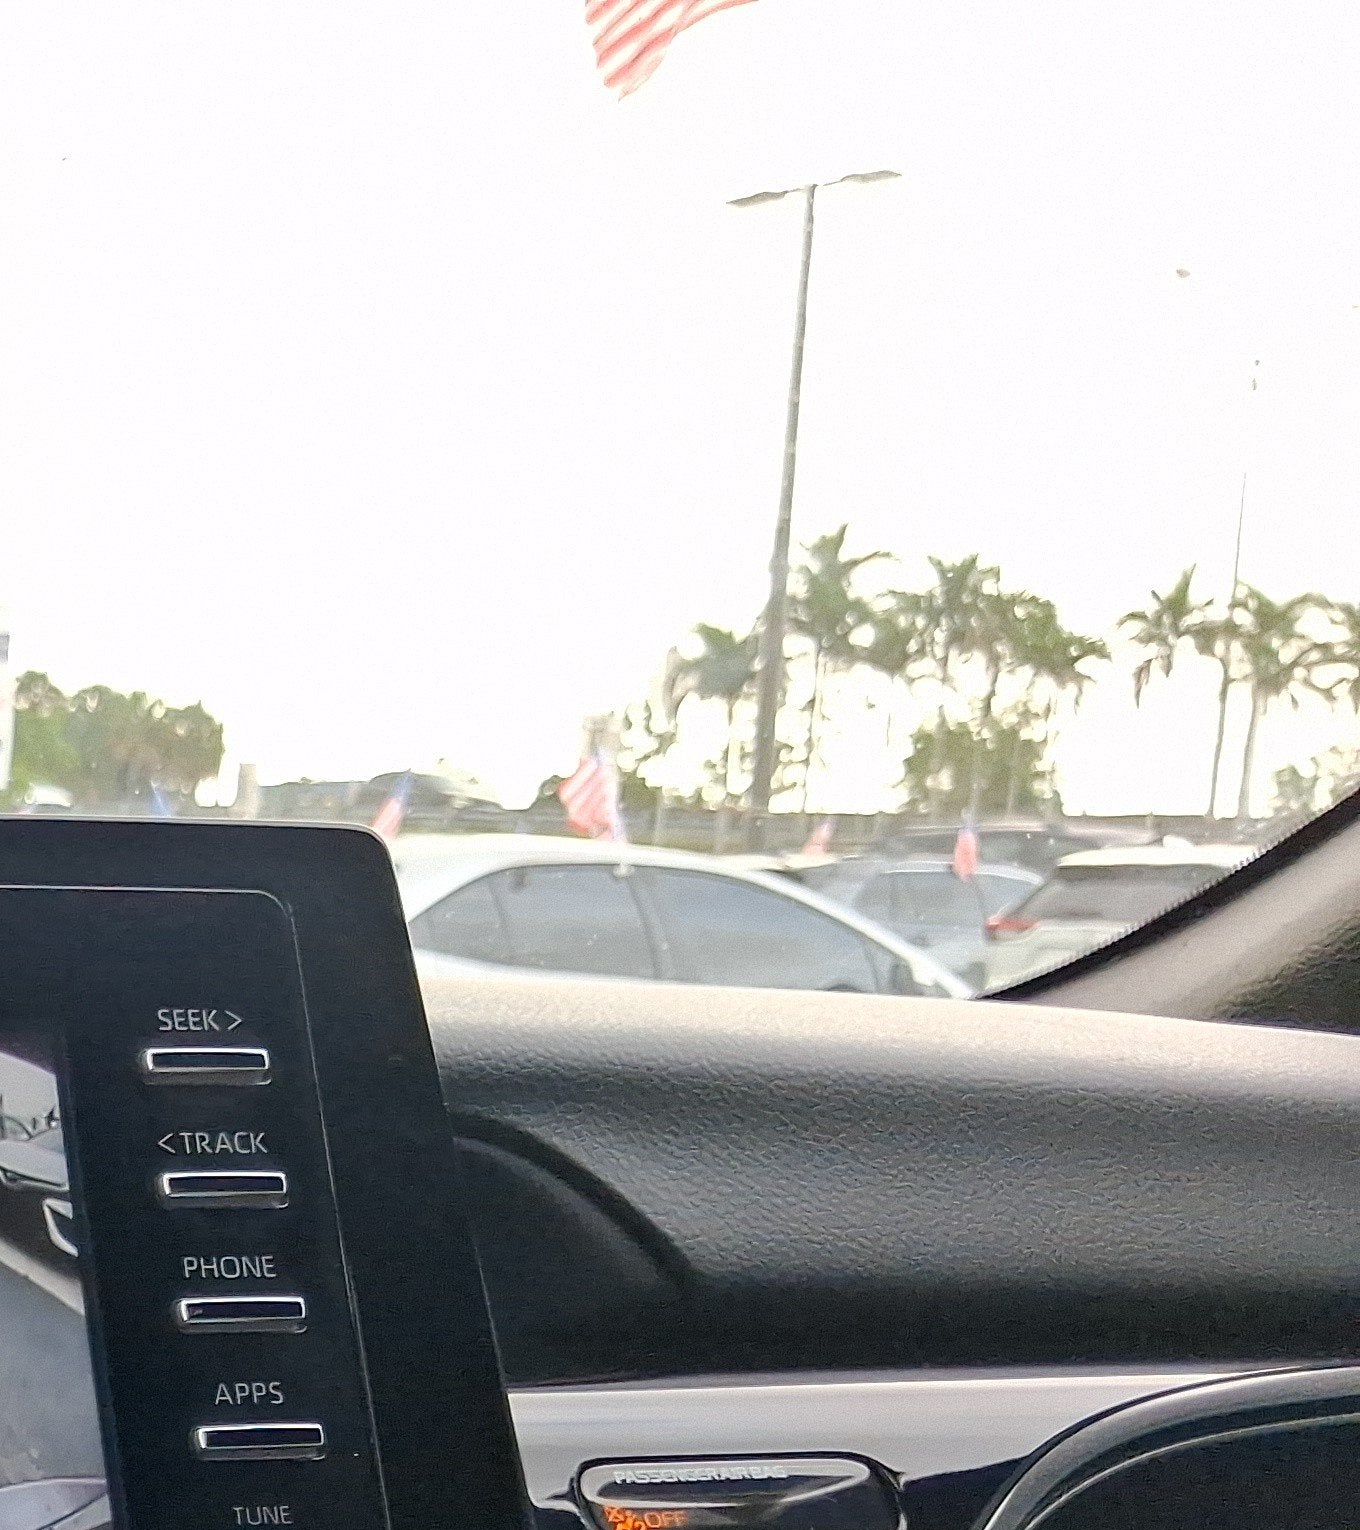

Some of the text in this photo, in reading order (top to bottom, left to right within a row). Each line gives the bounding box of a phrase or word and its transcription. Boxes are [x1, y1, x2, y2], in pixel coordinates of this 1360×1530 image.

[157, 1008, 220, 1032] SEEK
[180, 1131, 268, 1154] TRACK
[183, 1255, 278, 1279] PHONE
[214, 1381, 284, 1405] APPS
[232, 1505, 293, 1526] TUNE
